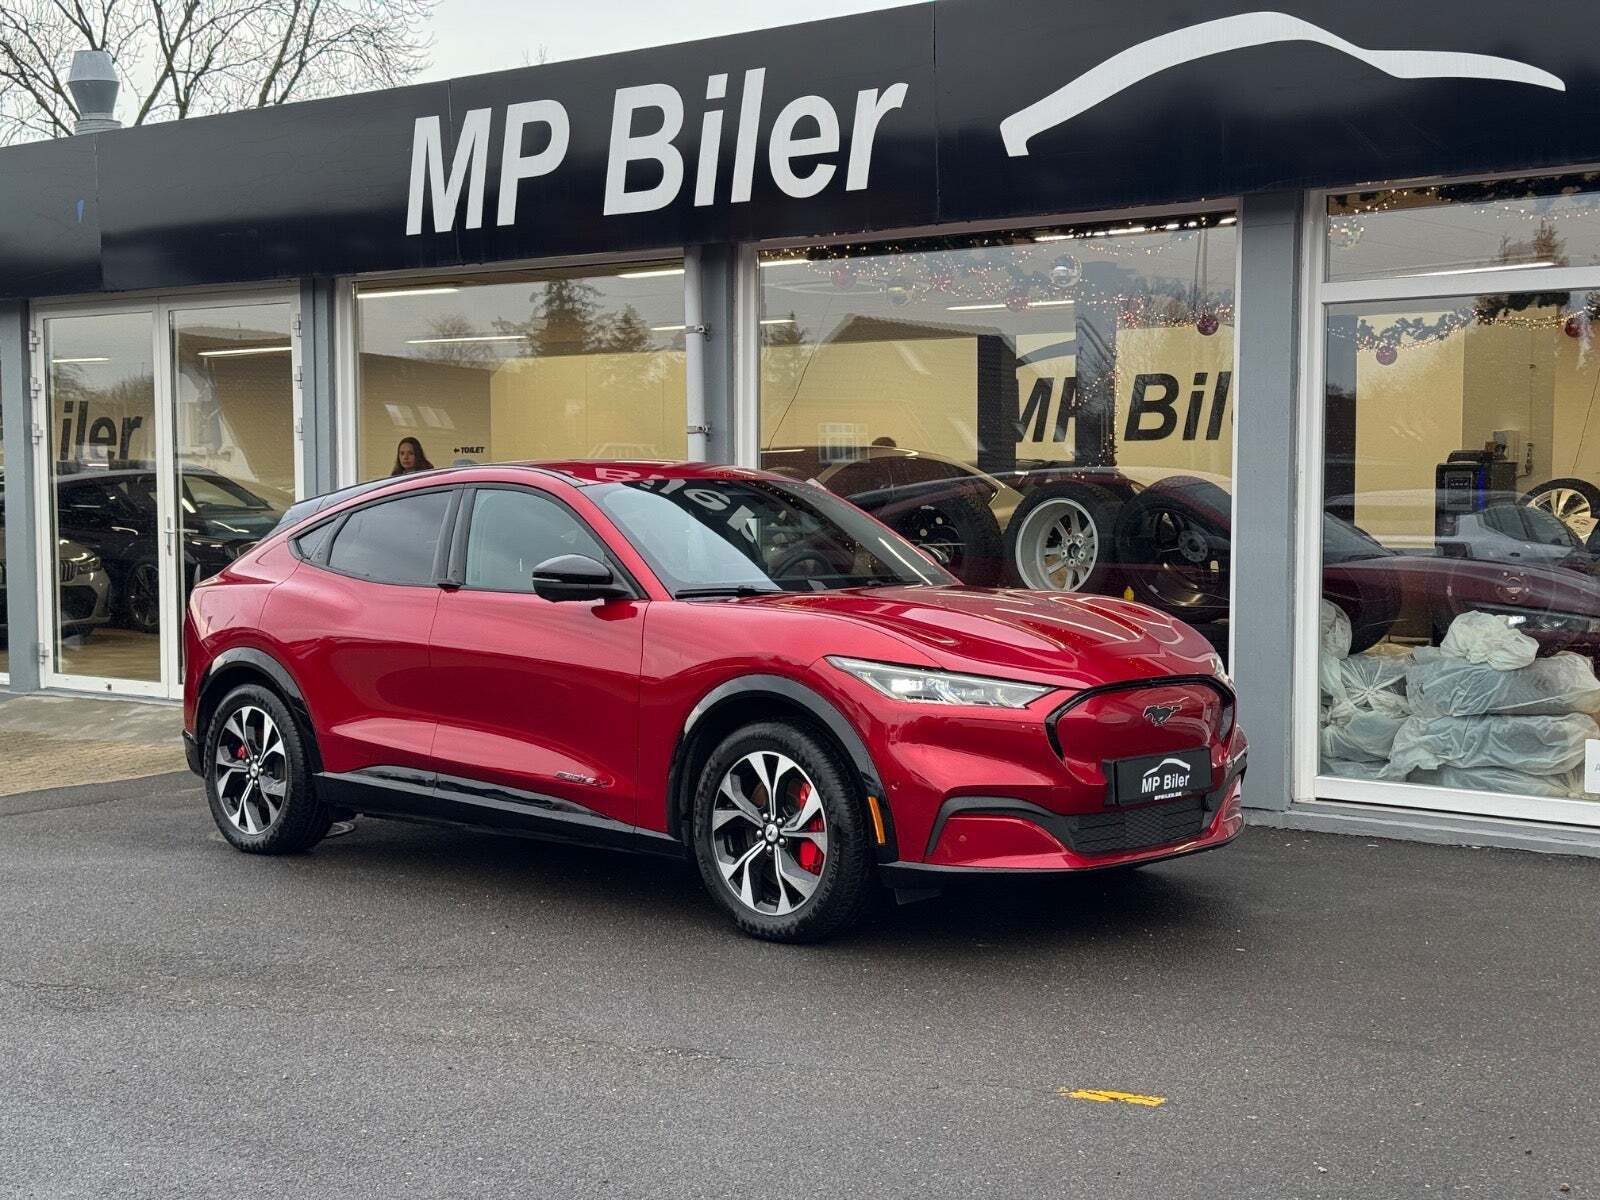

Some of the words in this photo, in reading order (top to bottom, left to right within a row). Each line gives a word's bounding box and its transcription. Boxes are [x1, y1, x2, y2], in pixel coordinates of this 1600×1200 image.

[405, 99, 571, 236] MP
[603, 67, 909, 216] Biler
[59, 400, 143, 461] iler
[1123, 370, 1234, 442] Bil
[460, 446, 485, 454] TOILET
[1141, 776, 1160, 793] MP
[1163, 773, 1190, 790] Biler
